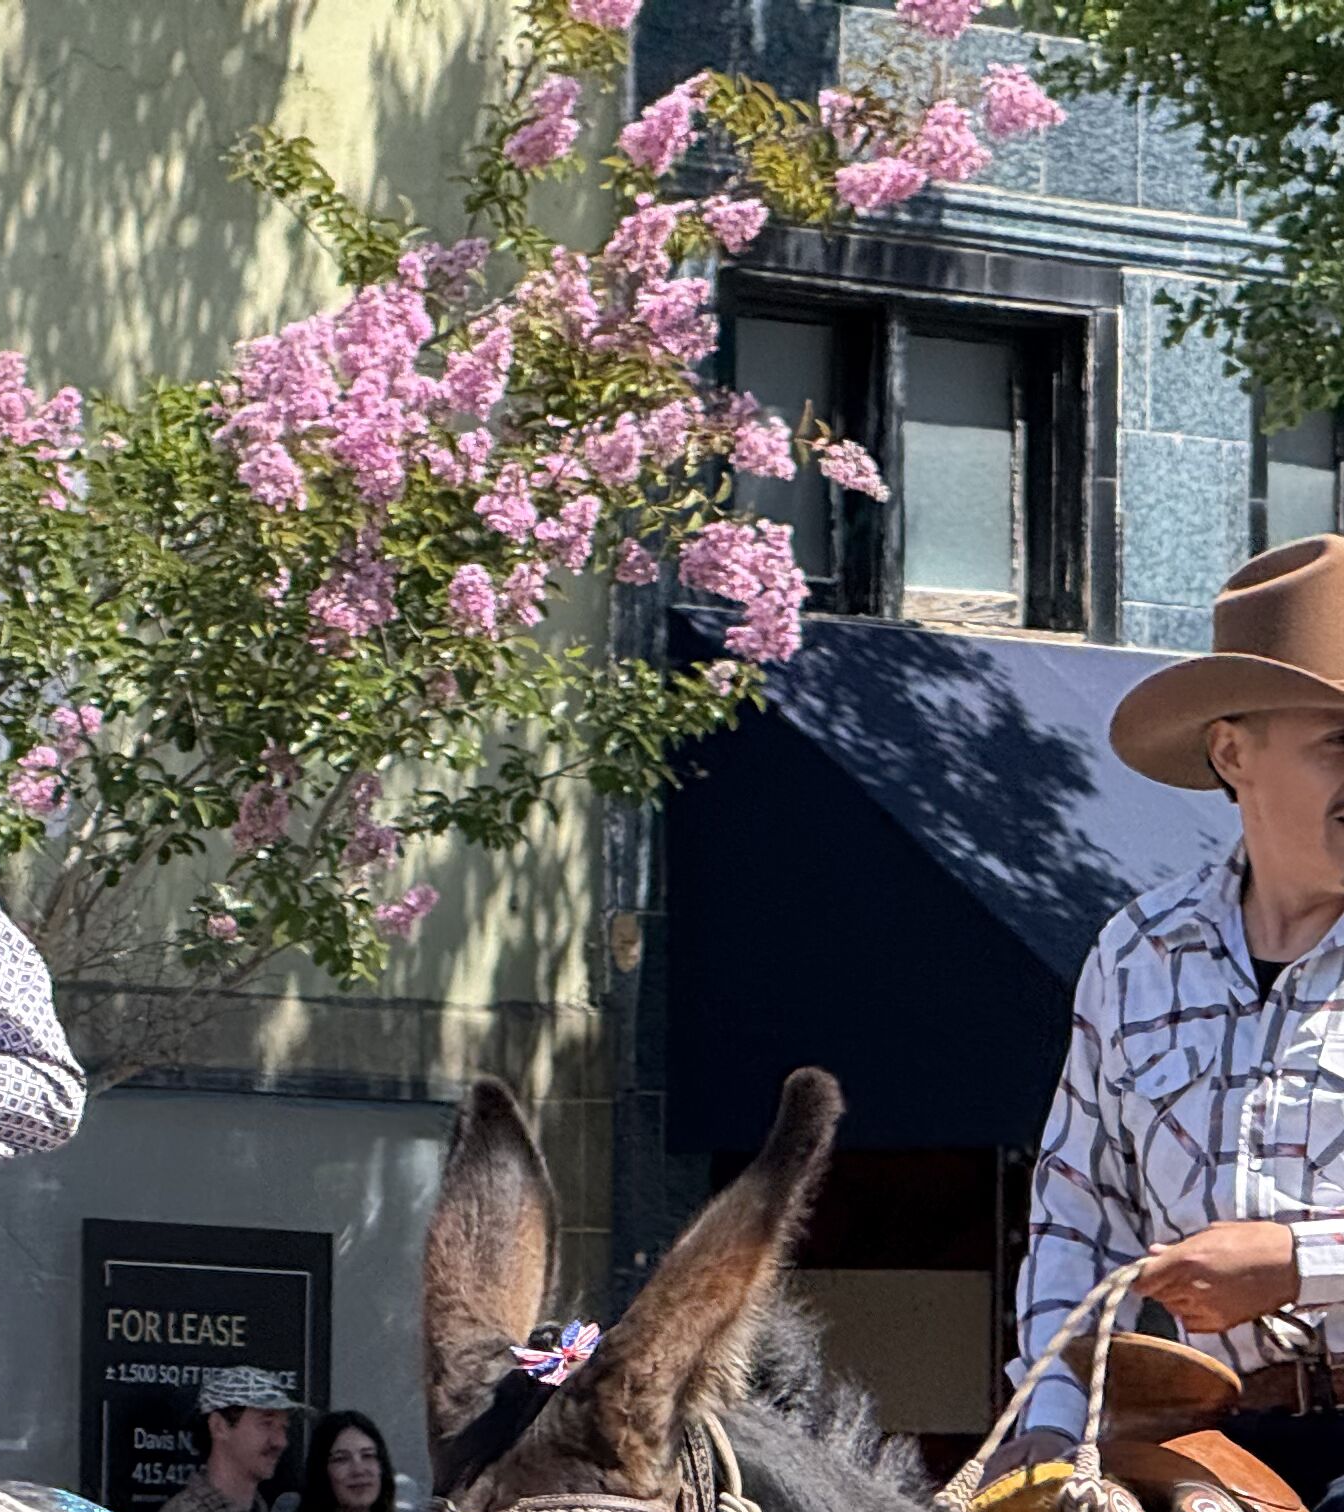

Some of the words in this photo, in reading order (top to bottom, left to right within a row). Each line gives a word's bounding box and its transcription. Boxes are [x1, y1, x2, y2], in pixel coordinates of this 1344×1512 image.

[107, 1308, 162, 1343] FOR
[168, 1311, 247, 1347] LEASE
[182, 1366, 201, 1385] FT
[133, 1427, 174, 1451] Davis
